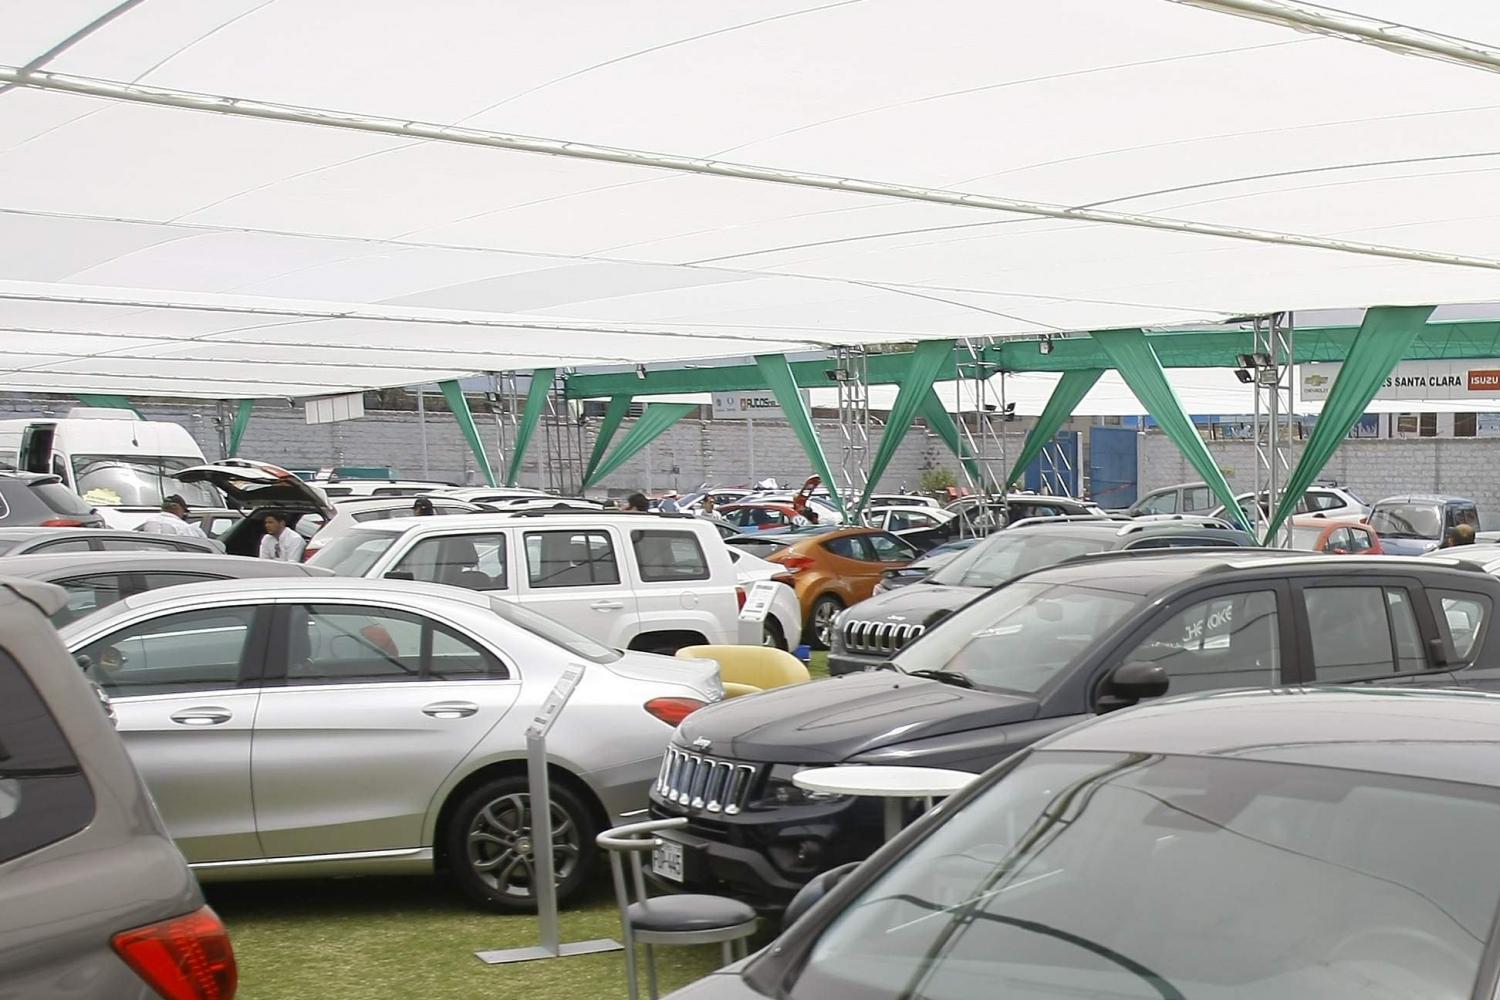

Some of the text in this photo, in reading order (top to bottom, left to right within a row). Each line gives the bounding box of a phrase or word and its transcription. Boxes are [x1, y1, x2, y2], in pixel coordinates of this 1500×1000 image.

[1394, 376, 1426, 387] SANTA
[1429, 376, 1462, 387] CLARA
[1470, 375, 1499, 386] ISUZU
